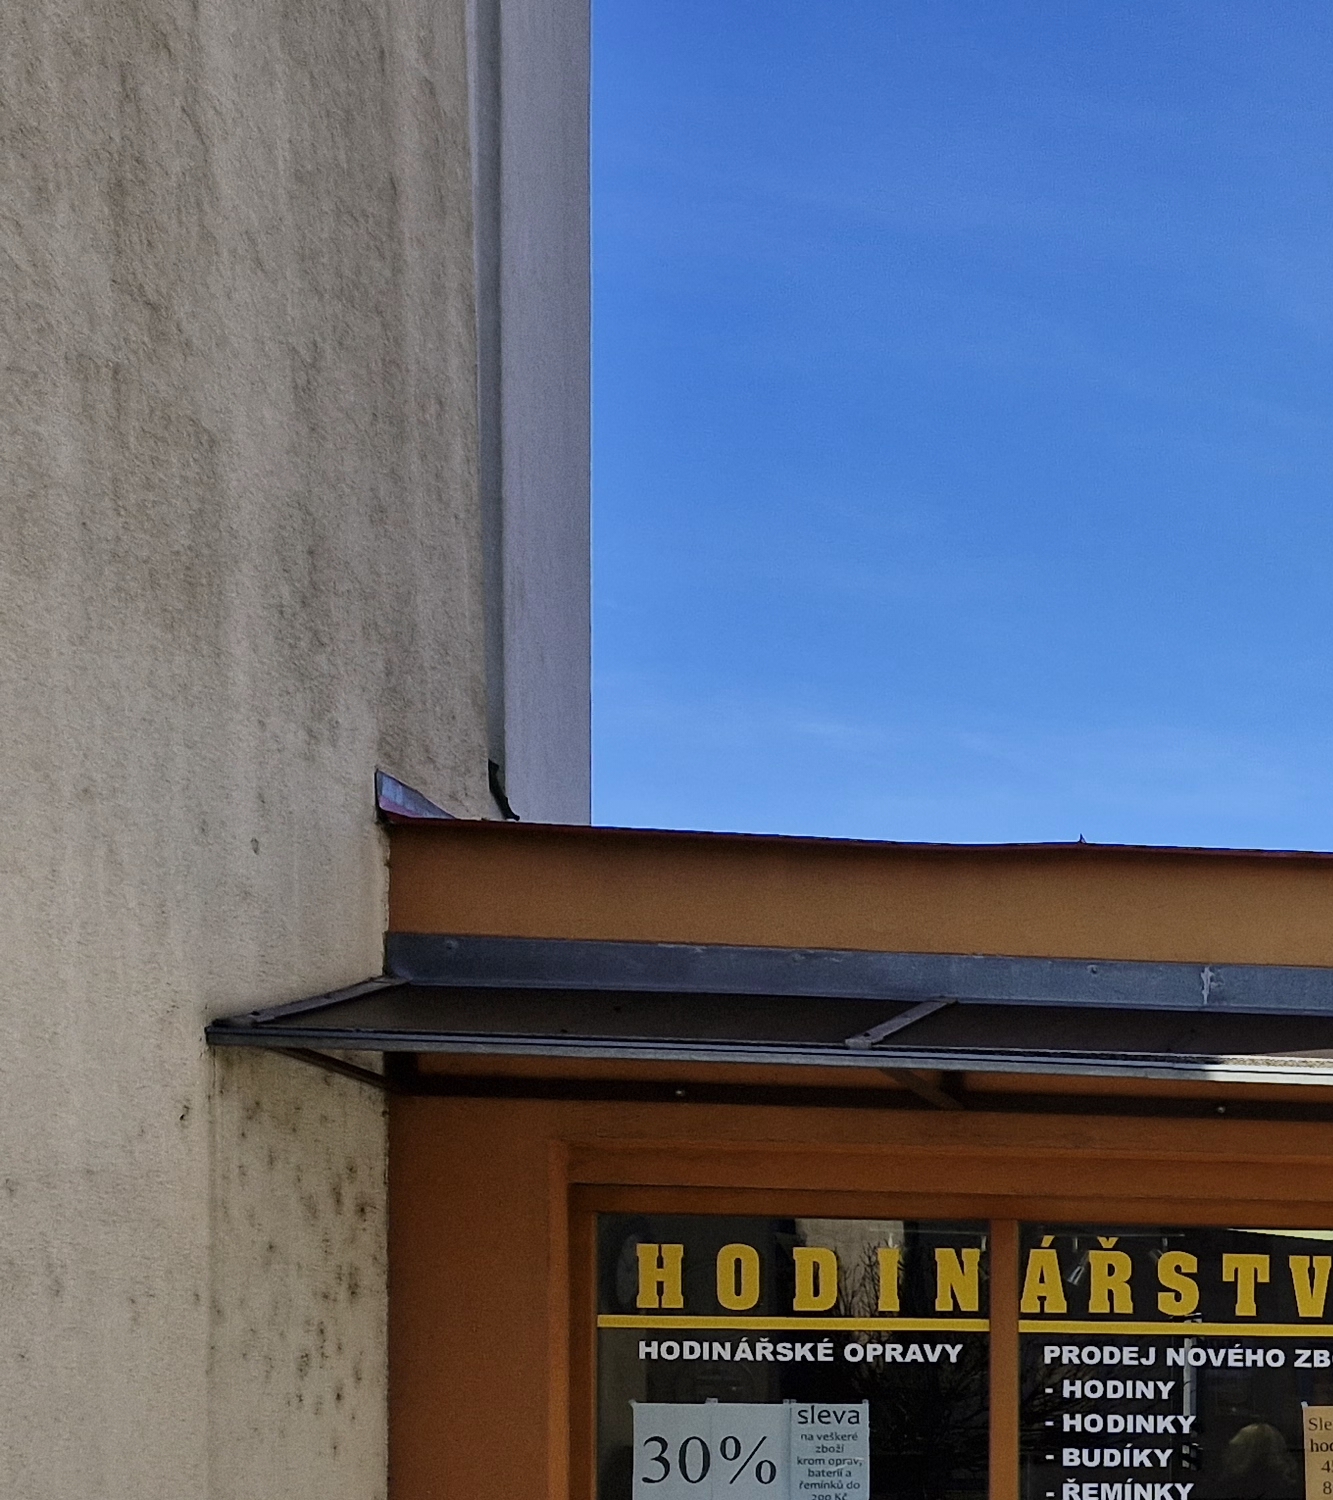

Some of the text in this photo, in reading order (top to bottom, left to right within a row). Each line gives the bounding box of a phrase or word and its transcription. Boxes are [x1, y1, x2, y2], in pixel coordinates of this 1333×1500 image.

[638, 1336, 963, 1363] HODINÁŘSKÉ OPRAVY
[1043, 1346, 1156, 1367] PRODEJ
[1166, 1343, 1285, 1368] NOVÉHO
[1062, 1380, 1175, 1399] HODINY
[797, 1405, 860, 1425] sleva
[1062, 1414, 1196, 1434] HODINKY
[801, 1431, 859, 1441] na veškeré
[815, 1444, 844, 1453] zboží
[1062, 1443, 1173, 1468] BUDÍKY
[641, 1435, 777, 1485] 30%
[796, 1456, 825, 1465] krom
[846, 1480, 861, 1490] do
